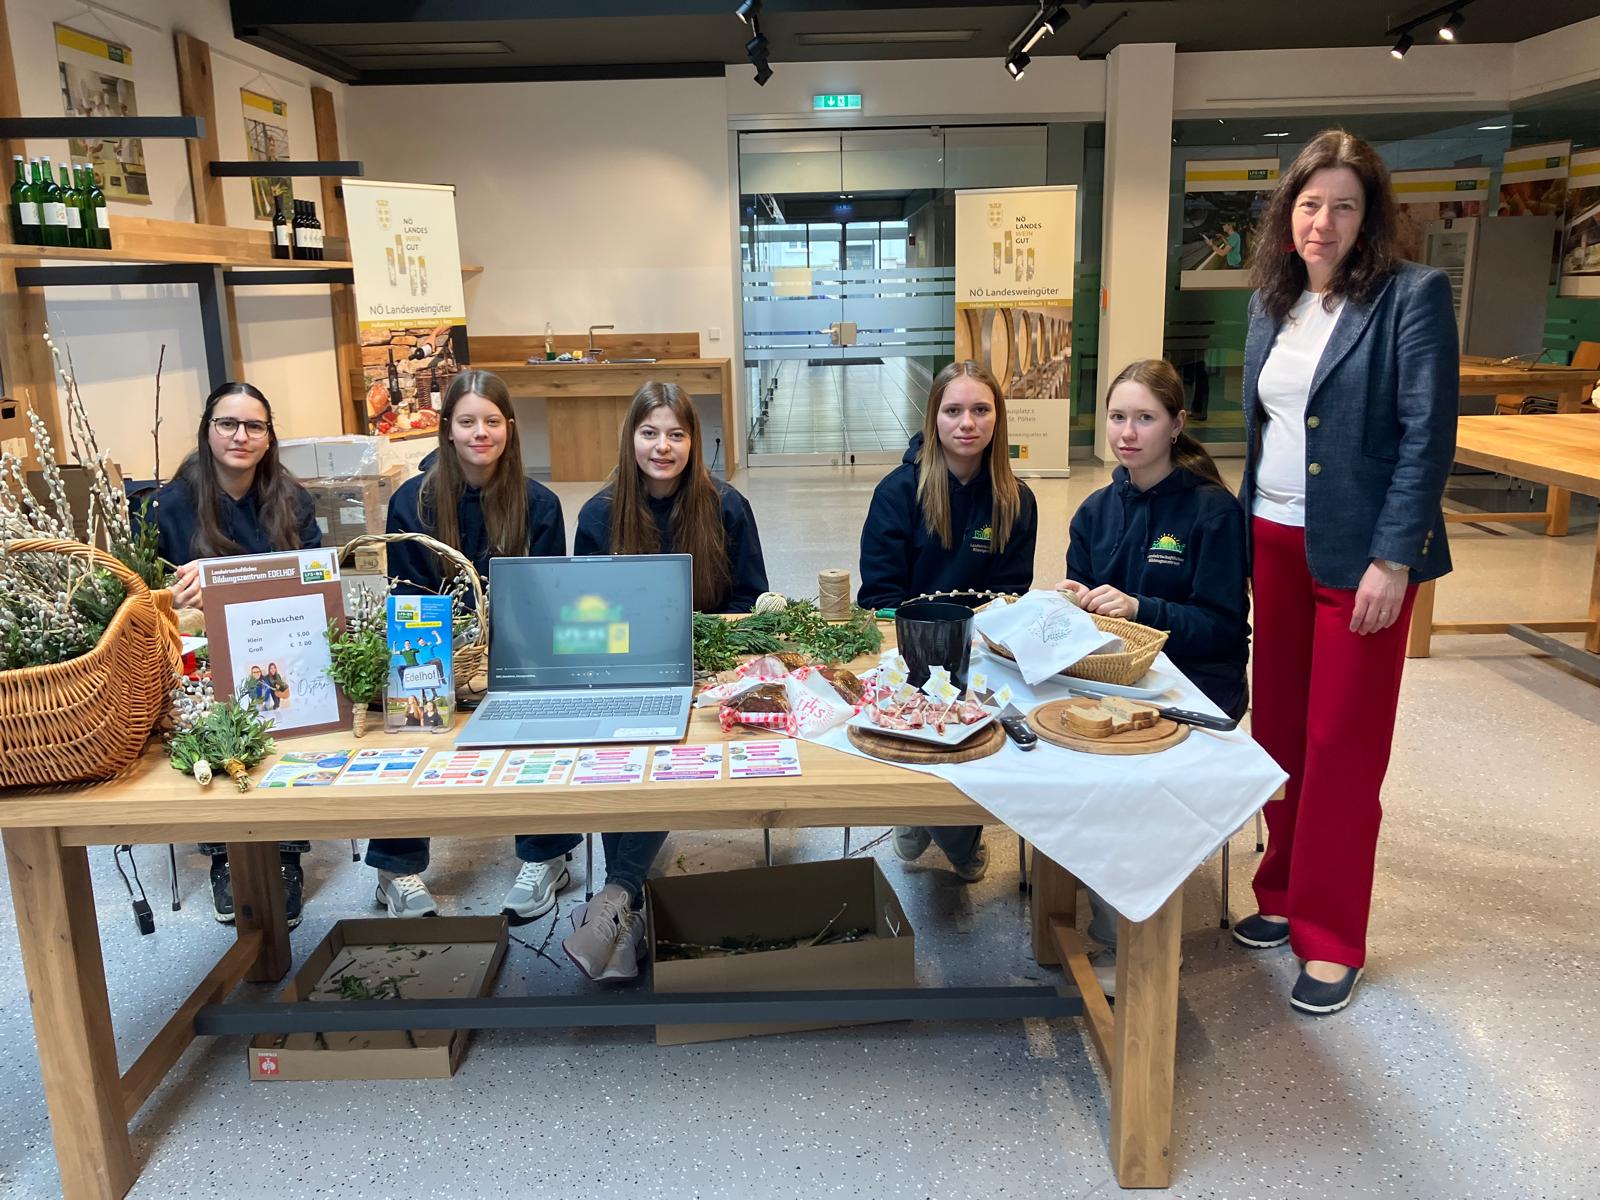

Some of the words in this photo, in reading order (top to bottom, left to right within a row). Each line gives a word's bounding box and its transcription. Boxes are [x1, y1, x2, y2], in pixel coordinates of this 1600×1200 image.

[403, 217, 413, 225] NÖ
[404, 226, 428, 234] LANDES
[406, 243, 419, 251] GUT
[969, 288, 984, 297] NÖ
[986, 287, 1060, 298] Landesweingüter
[369, 303, 383, 315] NÖ
[386, 303, 452, 315] Landesweingüter
[212, 573, 267, 584] Bildungszentrum
[267, 568, 296, 579] EDELHOF
[251, 615, 305, 626] Palmbuschen
[404, 670, 436, 683] Edelhof
